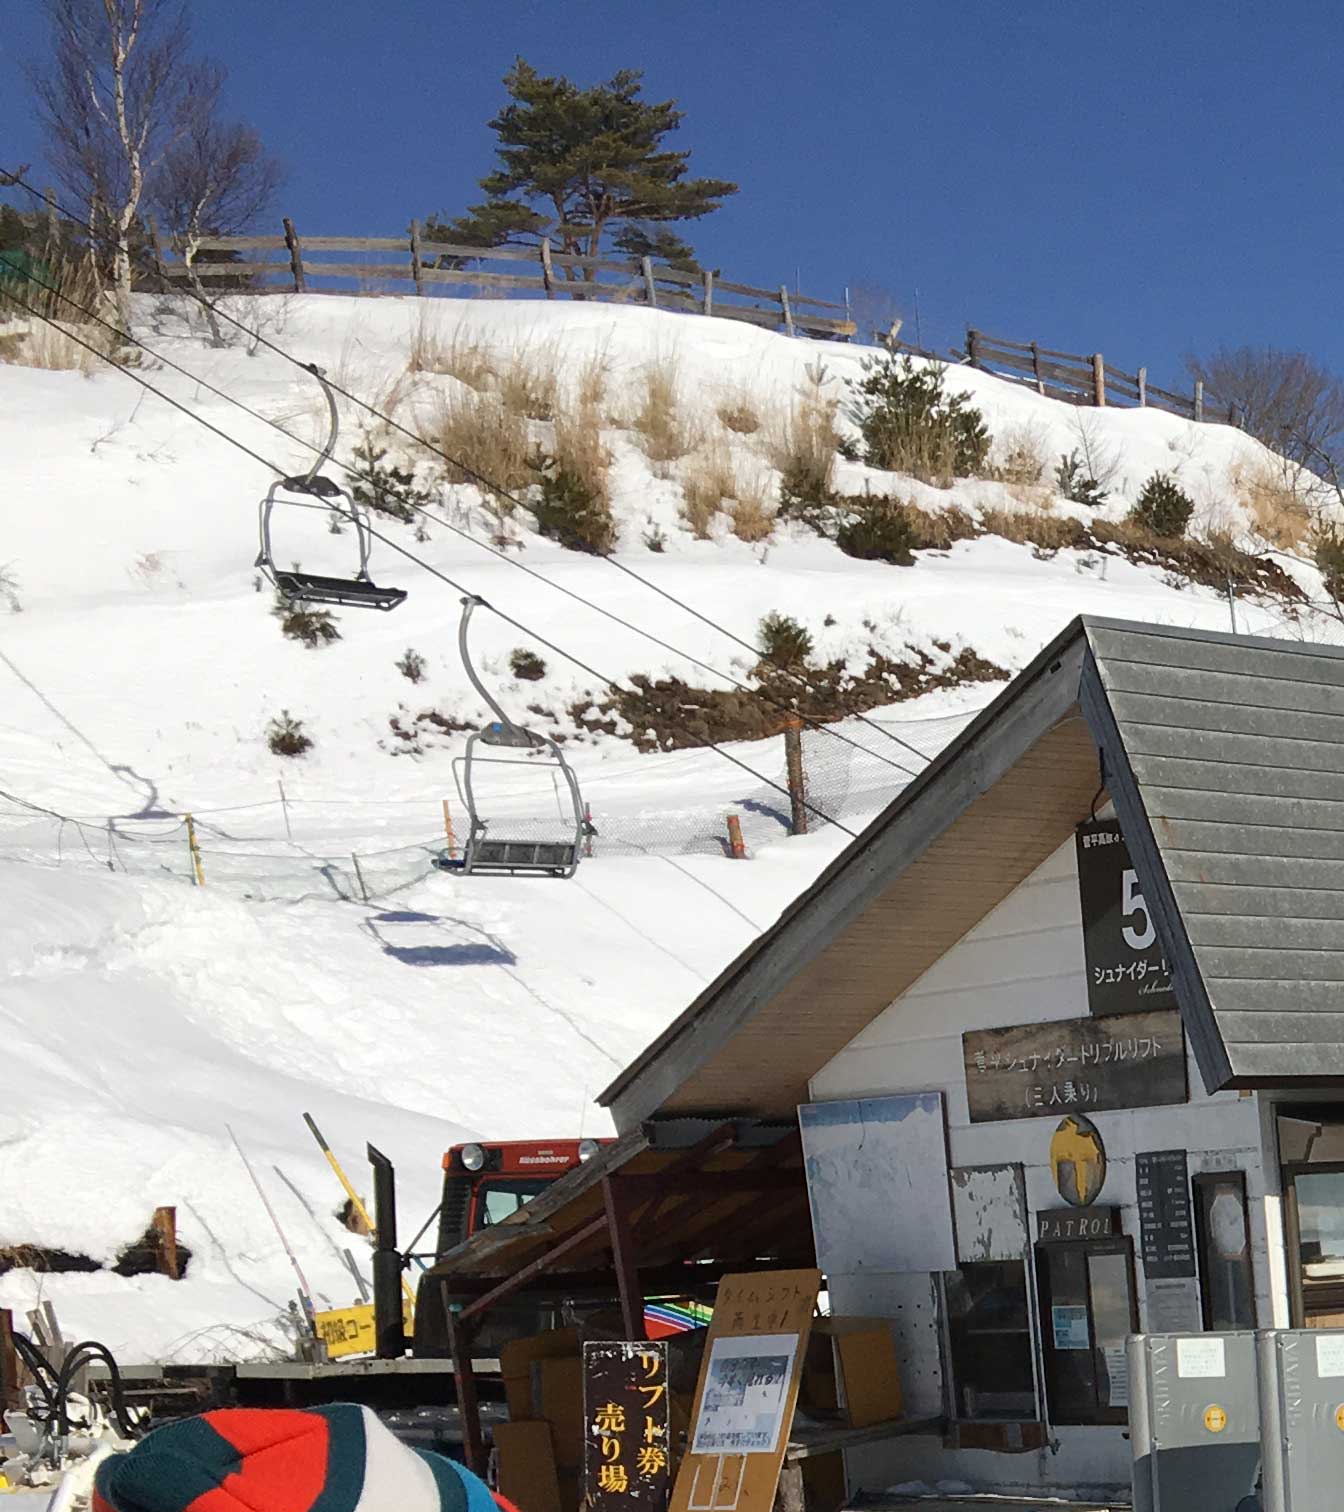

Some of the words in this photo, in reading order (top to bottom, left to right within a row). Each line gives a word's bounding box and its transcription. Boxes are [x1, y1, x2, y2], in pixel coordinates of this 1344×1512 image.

[1122, 868, 1157, 950] 5
[1040, 1218, 1109, 1239] PATROL
[595, 1402, 629, 1493] 売り場
[637, 1352, 666, 1476] リフト券
